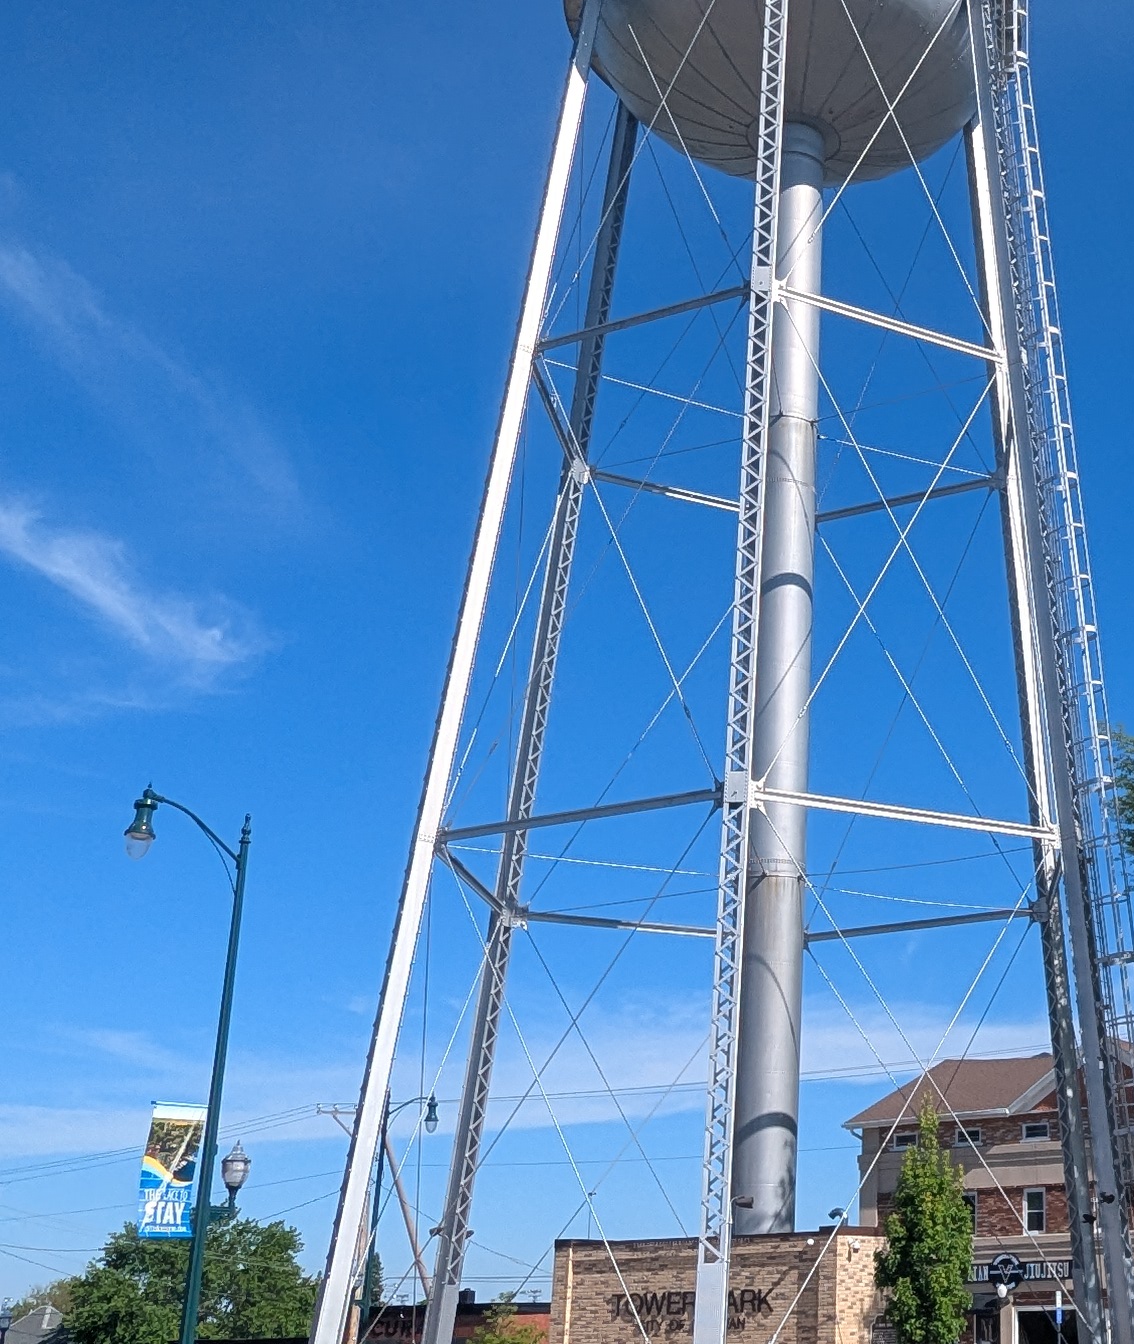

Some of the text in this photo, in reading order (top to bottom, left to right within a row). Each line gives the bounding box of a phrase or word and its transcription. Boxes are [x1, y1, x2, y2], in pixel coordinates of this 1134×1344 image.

[144, 1188, 162, 1201] THE
[145, 1202, 185, 1225] STAY
[727, 1288, 774, 1313] ARK
